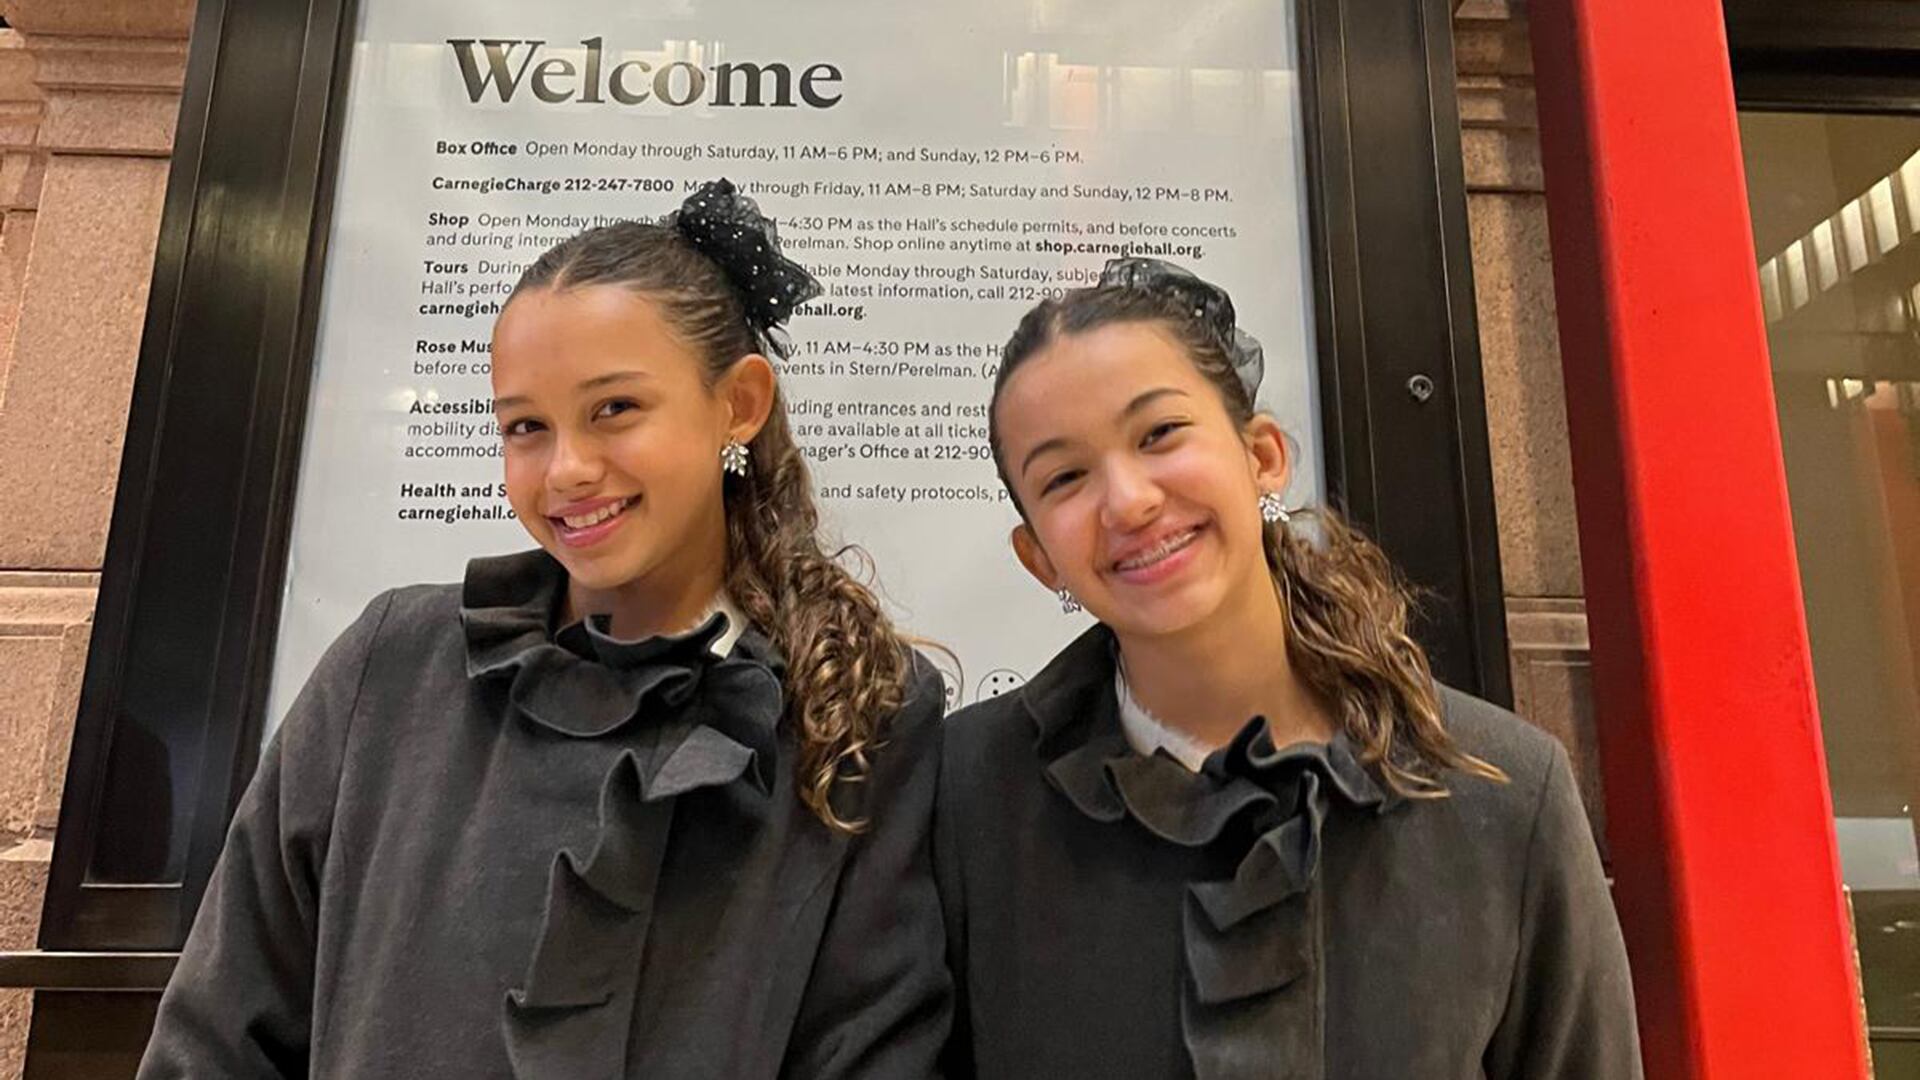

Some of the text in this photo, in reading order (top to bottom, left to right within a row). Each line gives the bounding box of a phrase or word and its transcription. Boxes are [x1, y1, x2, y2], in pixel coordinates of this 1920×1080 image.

[446, 36, 843, 109] Welcome
[437, 141, 1083, 165] Box Office Open Monday through Saturday, 11 AM–6 PM; and Sunday, 12 PM–6 PM.
[432, 177, 560, 194] CarnegieCharge
[565, 178, 674, 192] 212-247-7800
[750, 181, 809, 199] through
[814, 182, 864, 198] Friday,
[869, 183, 880, 195] 11
[885, 183, 931, 196] AM–8
[936, 184, 965, 198] PM;
[970, 184, 1036, 200] Saturday
[1040, 185, 1068, 197] and
[1074, 185, 1132, 202] Sunday,
[1136, 187, 1151, 200] 12
[1156, 187, 1200, 201] PM–8
[1205, 189, 1232, 202] PM.
[429, 212, 469, 229] Shop
[478, 213, 521, 230] Open
[526, 214, 589, 231] Monday
[828, 217, 852, 230] PM
[857, 221, 874, 231] as
[878, 218, 902, 231] the
[907, 218, 947, 231] Hall's
[951, 219, 1018, 232] schedule
[1023, 220, 1083, 238] permits,
[1086, 221, 1114, 235] and
[1119, 222, 1168, 236] before
[1172, 226, 1237, 238] concerts
[426, 232, 456, 246] and
[461, 232, 513, 249] during
[854, 237, 893, 252] Shop
[897, 237, 945, 250] online
[950, 238, 1012, 253] anytime
[1016, 240, 1030, 251] at
[1036, 240, 1206, 259] shop.carnegiehall.org.
[424, 261, 468, 274] Tours
[847, 264, 910, 281] Monday
[914, 265, 975, 282] through
[981, 266, 1052, 283] Saturday,
[422, 280, 464, 294] Hall's
[470, 281, 512, 298] perfo
[830, 283, 873, 297] latest
[878, 283, 973, 301] information,
[977, 286, 1004, 299] call
[1009, 287, 1068, 300] 212-90
[420, 301, 499, 319] carnegieh
[416, 340, 456, 353] Rose
[807, 341, 818, 354] 11
[824, 341, 899, 355] AM–4:30
[904, 342, 929, 356] PM
[935, 346, 952, 356] as
[957, 343, 981, 357] the
[414, 360, 467, 375] before
[830, 361, 844, 375] in
[849, 361, 976, 377] Stern/Perelman.
[410, 400, 496, 414] Accessibil
[838, 402, 916, 416] entrances
[921, 402, 951, 417] and
[408, 421, 475, 439] mobility
[797, 426, 823, 436] are
[828, 422, 900, 437] available
[905, 425, 919, 437] at
[925, 423, 943, 438] all
[949, 425, 986, 438] ticke
[860, 444, 909, 458] Office
[914, 446, 929, 459] at
[934, 446, 991, 460] 212-90
[401, 483, 456, 497] Health
[461, 484, 492, 497] and
[820, 484, 851, 498] and
[857, 484, 906, 503] safety
[911, 485, 993, 502] protocols,
[398, 506, 517, 523] carnegiehall.o
